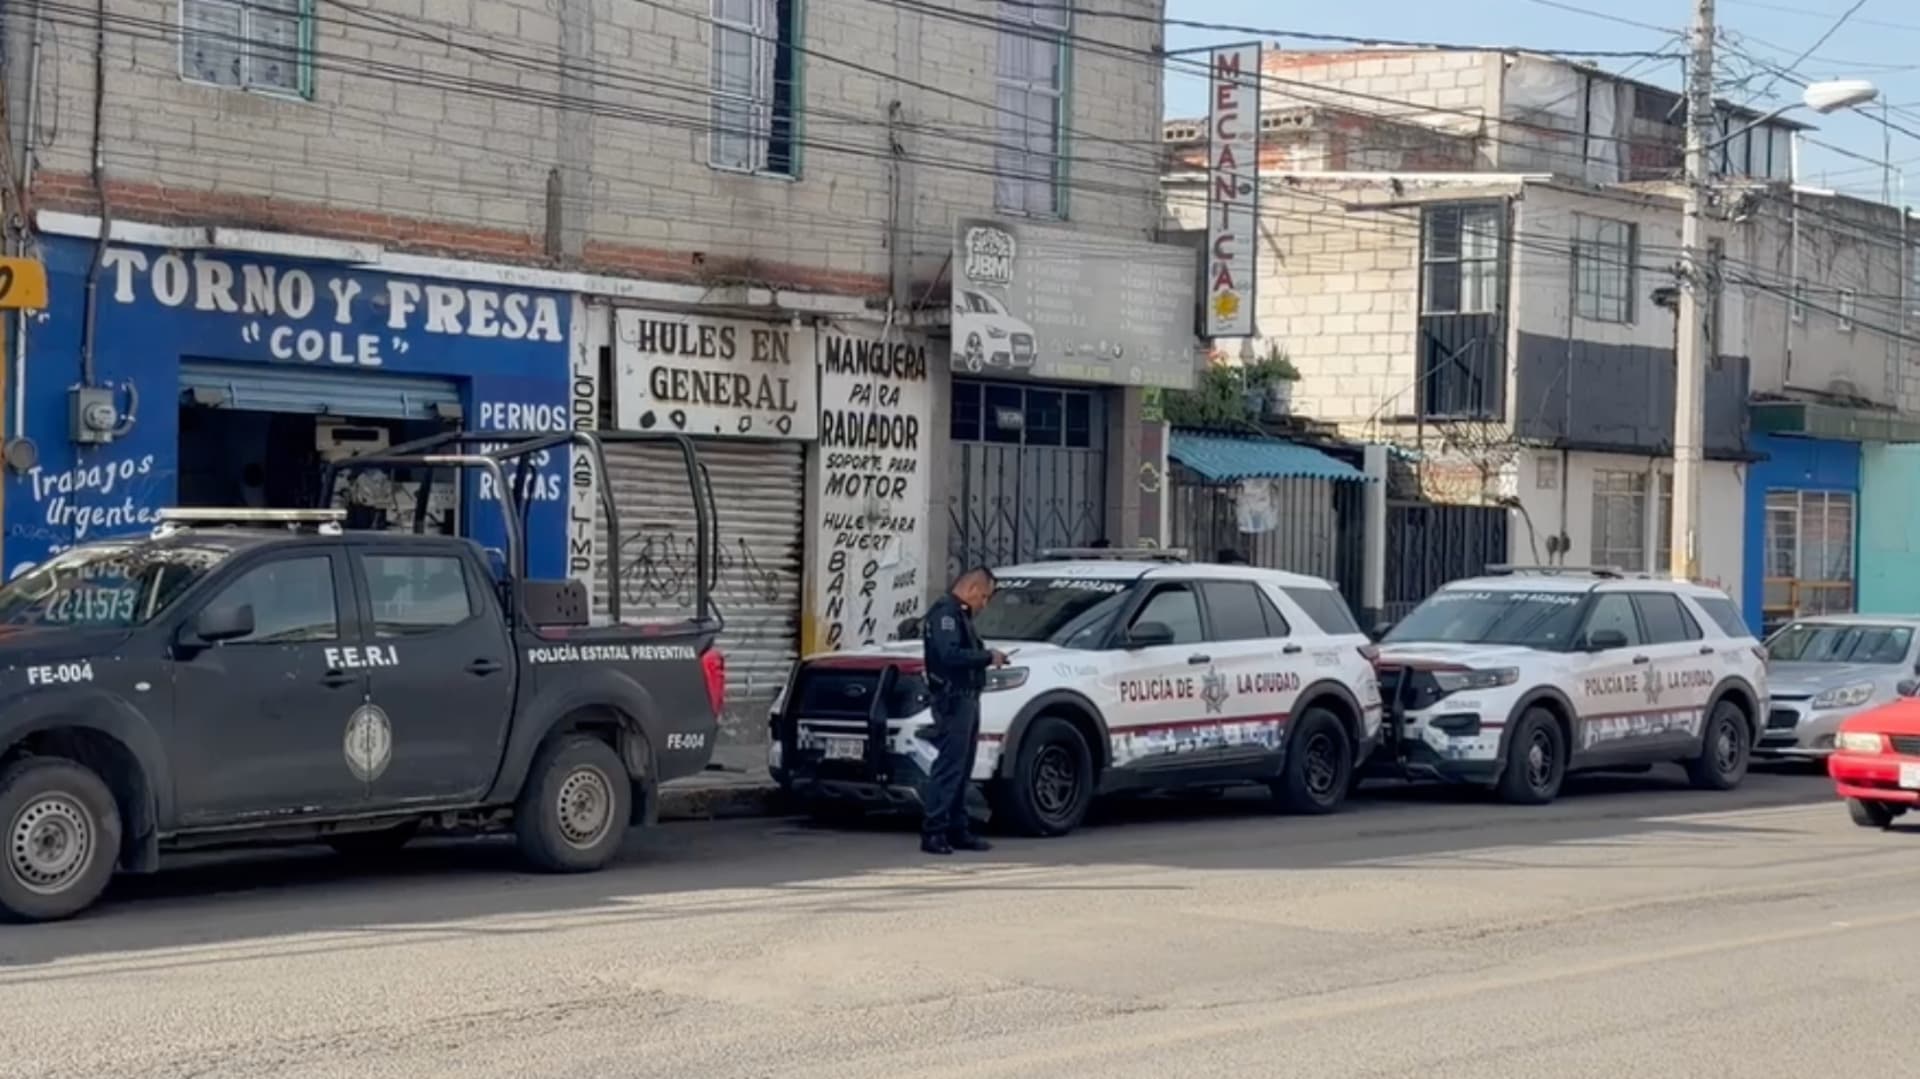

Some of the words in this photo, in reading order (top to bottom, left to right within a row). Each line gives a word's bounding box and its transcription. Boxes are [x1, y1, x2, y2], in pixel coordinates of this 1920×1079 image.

[1213, 53, 1240, 291] MECANICA
[968, 254, 1009, 280] JBM
[101, 247, 315, 320] TORNO
[329, 277, 361, 324] Y
[387, 281, 562, 342] FRESA
[637, 319, 736, 360] HULES
[751, 328, 791, 364] EN
[825, 335, 927, 380] MANGUERA
[650, 365, 798, 412] GENERAL
[848, 383, 900, 407] PARA
[480, 401, 567, 431] PERNOS
[573, 363, 595, 487] LODEAS
[820, 409, 919, 450] RADIADOR
[826, 453, 882, 471] SOPORTE
[888, 457, 916, 472] PARA
[28, 454, 154, 502] Trabajos
[824, 473, 907, 498] MOTOR
[46, 498, 163, 538] Urgentes
[823, 513, 864, 530] HULE
[880, 516, 915, 532] PARA
[571, 506, 592, 576] LIMP
[834, 533, 891, 551] PUERT
[859, 560, 879, 645] ORIN
[325, 645, 399, 669] F.E.R.I
[581, 646, 629, 661] ESTATAL
[631, 645, 696, 660] PREVENTIVA
[27, 664, 93, 685] FE-004
[1120, 674, 1174, 702] POLICÍA
[1177, 677, 1194, 698] DE
[1236, 673, 1252, 694] LA
[1256, 672, 1300, 694] CIUDAD
[1624, 675, 1638, 692] DE
[1667, 671, 1682, 689] LA
[1681, 669, 1713, 688] CIUDAD
[667, 733, 704, 749] FE-004
